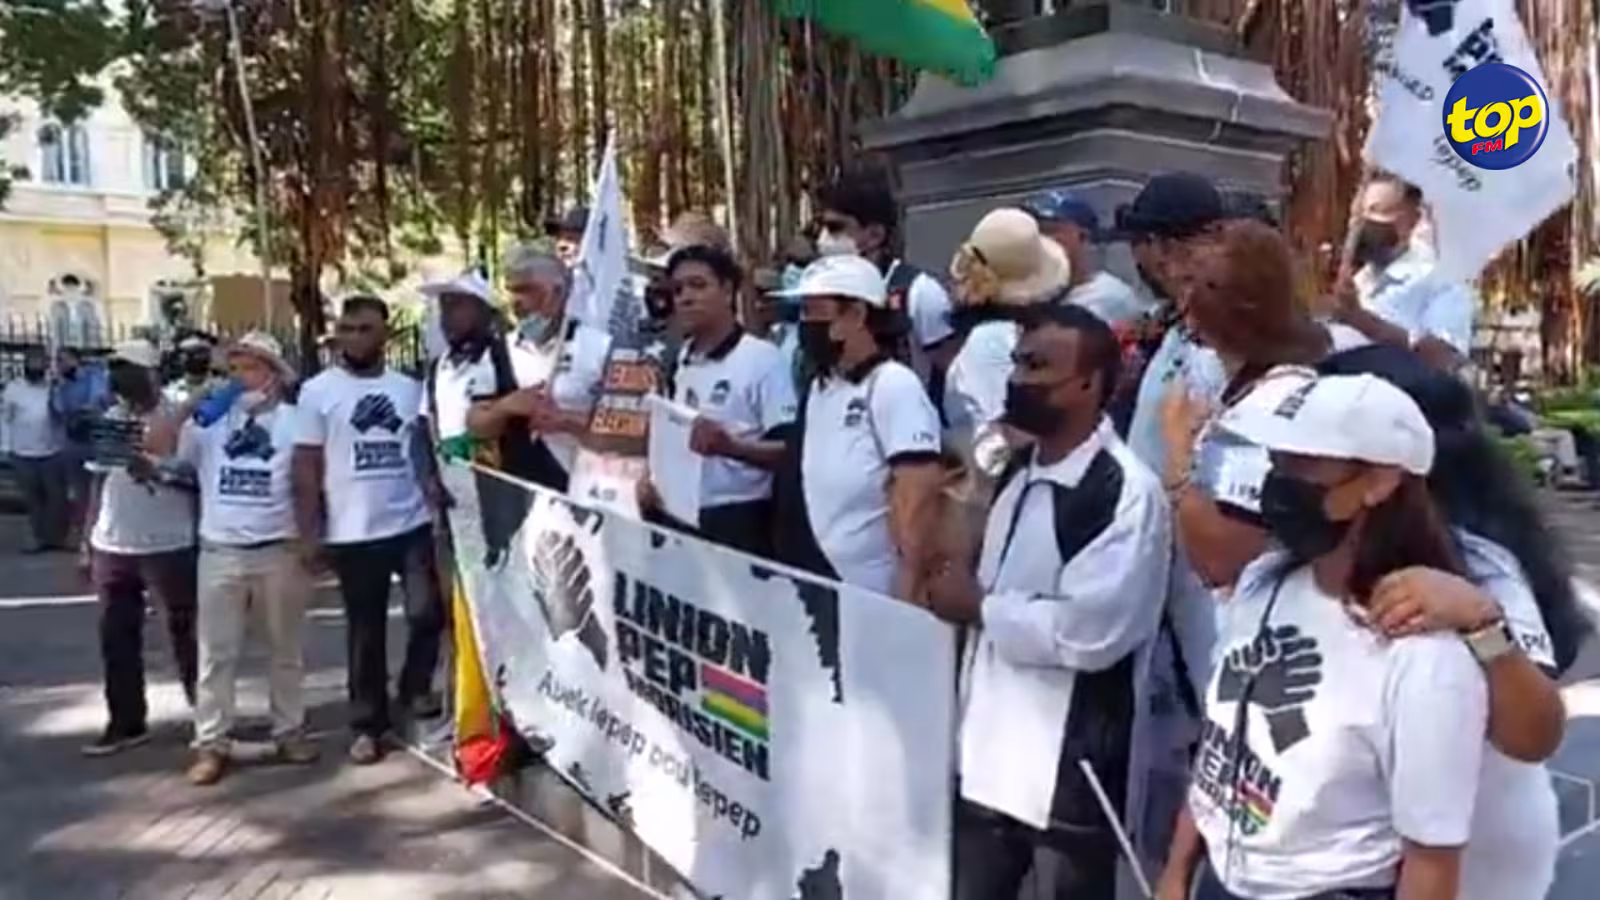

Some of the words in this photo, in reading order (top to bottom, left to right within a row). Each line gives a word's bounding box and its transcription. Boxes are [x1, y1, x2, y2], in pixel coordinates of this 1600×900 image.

[614, 570, 771, 685] UNION
[616, 619, 698, 695] PEP
[588, 696, 647, 756] lepep
[692, 761, 762, 841] lepep
